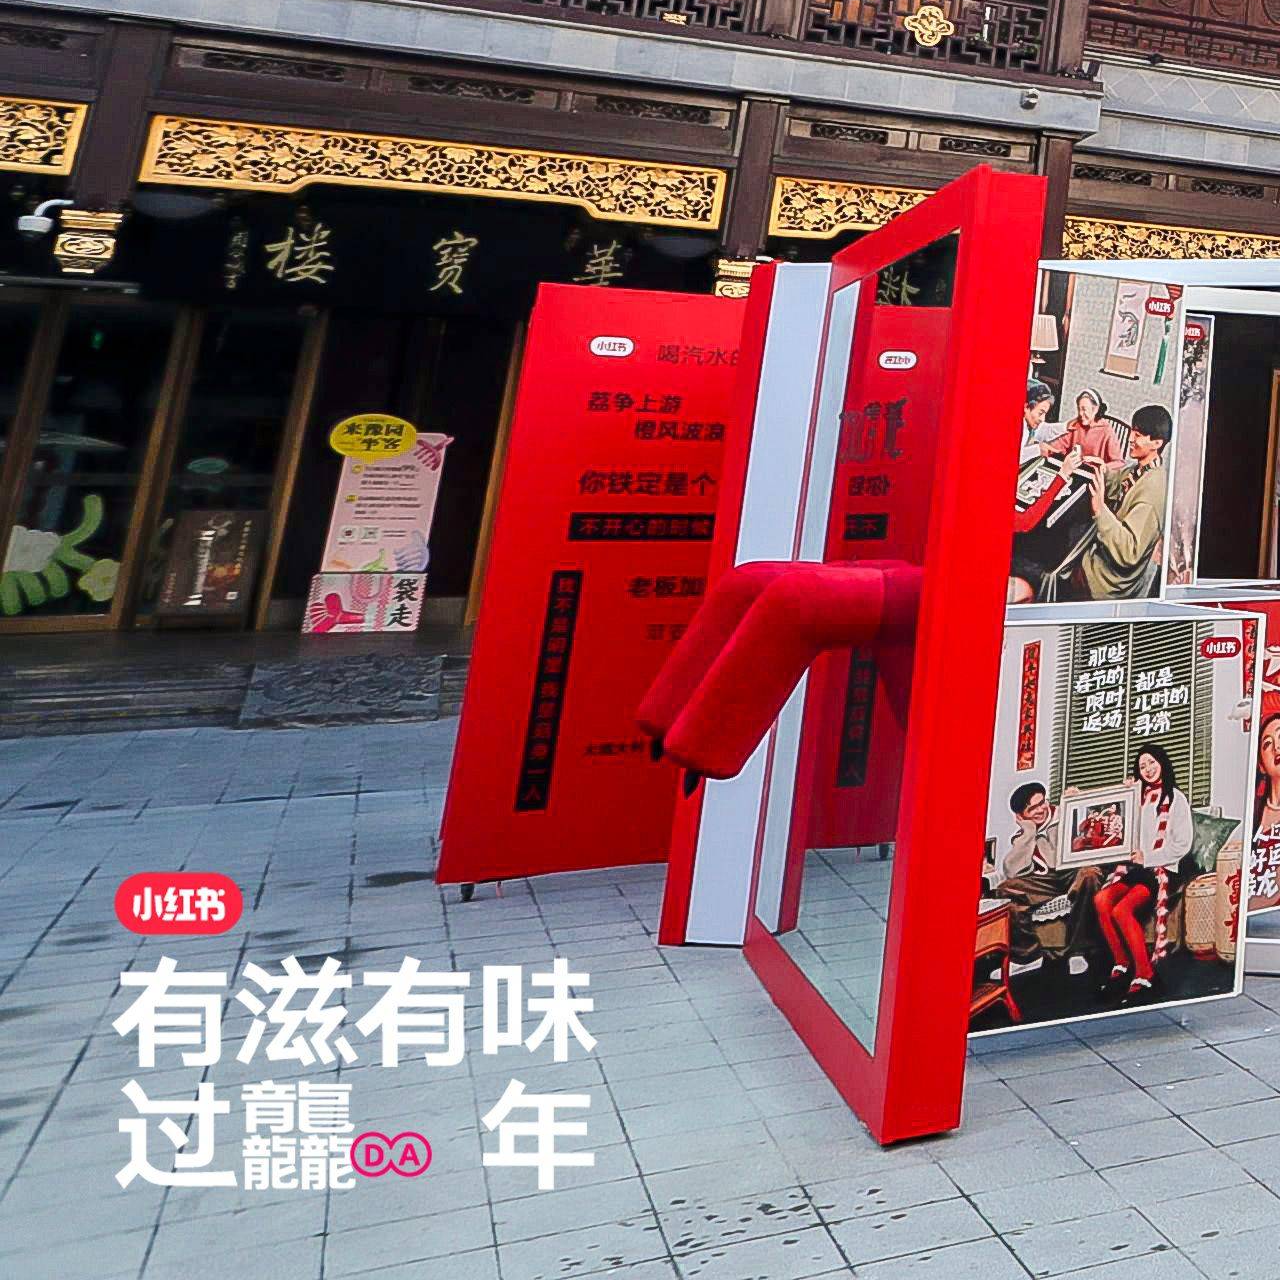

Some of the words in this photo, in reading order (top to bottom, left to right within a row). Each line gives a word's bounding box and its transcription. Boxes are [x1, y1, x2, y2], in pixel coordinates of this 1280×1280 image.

[597, 340, 628, 353] 小红书
[1088, 641, 1127, 668] 那些
[1205, 641, 1237, 655] 小红书
[1074, 665, 1125, 693] 春节的
[1134, 666, 1174, 692] 都是
[1085, 685, 1125, 713] 限时
[1132, 684, 1189, 710] 儿时的
[1081, 710, 1123, 732] 返场
[1132, 710, 1172, 737] 寻常
